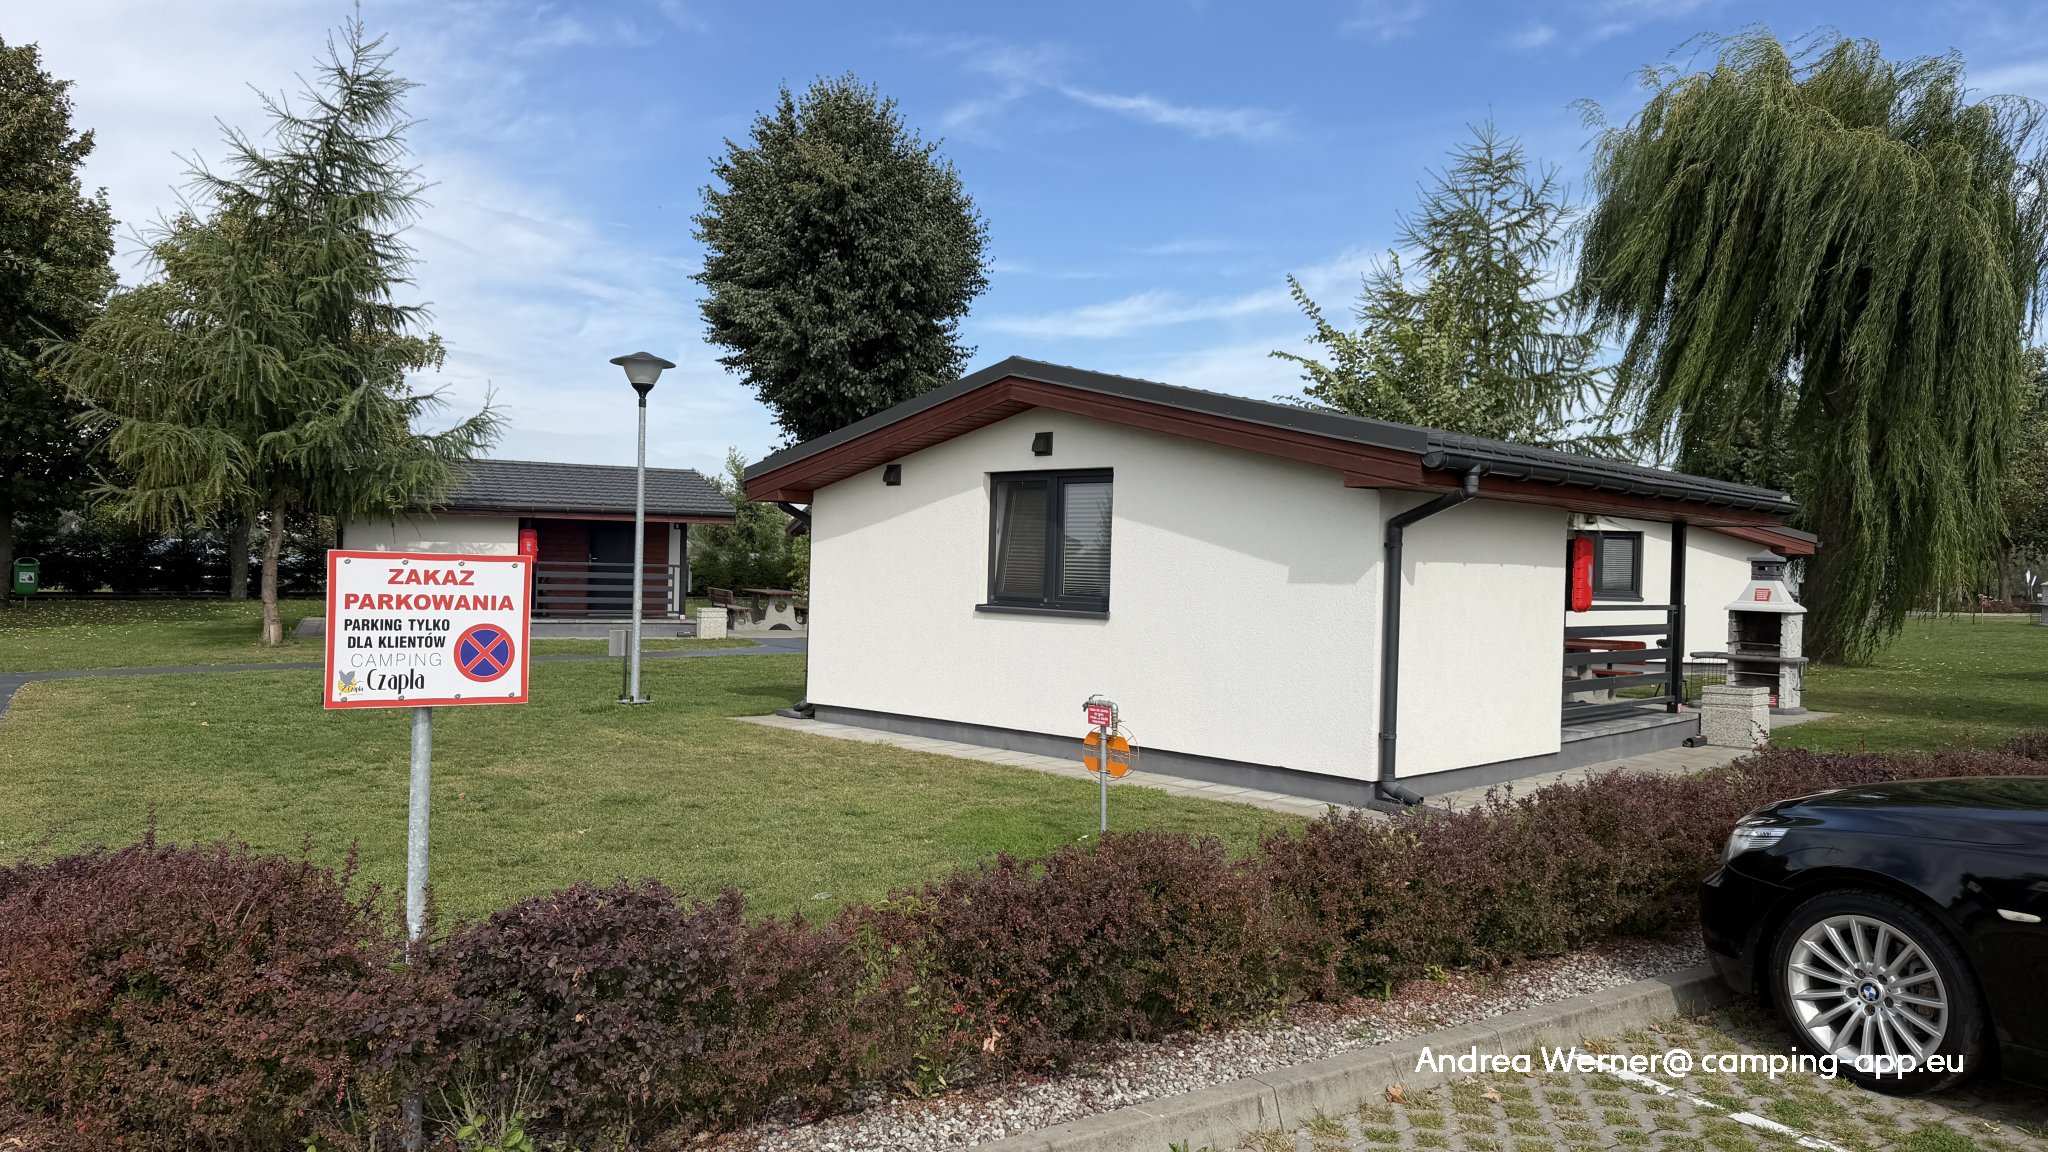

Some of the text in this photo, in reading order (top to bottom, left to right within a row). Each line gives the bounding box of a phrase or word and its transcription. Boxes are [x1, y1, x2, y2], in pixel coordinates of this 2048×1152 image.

[387, 568, 475, 586] ZAKAZ
[344, 593, 514, 611] PARKOWANIA
[344, 618, 450, 631] PARKING TYLKO
[347, 633, 446, 649] DLA KLIENTÓW
[350, 652, 442, 668] CAMPING
[366, 668, 425, 695] Czapla
